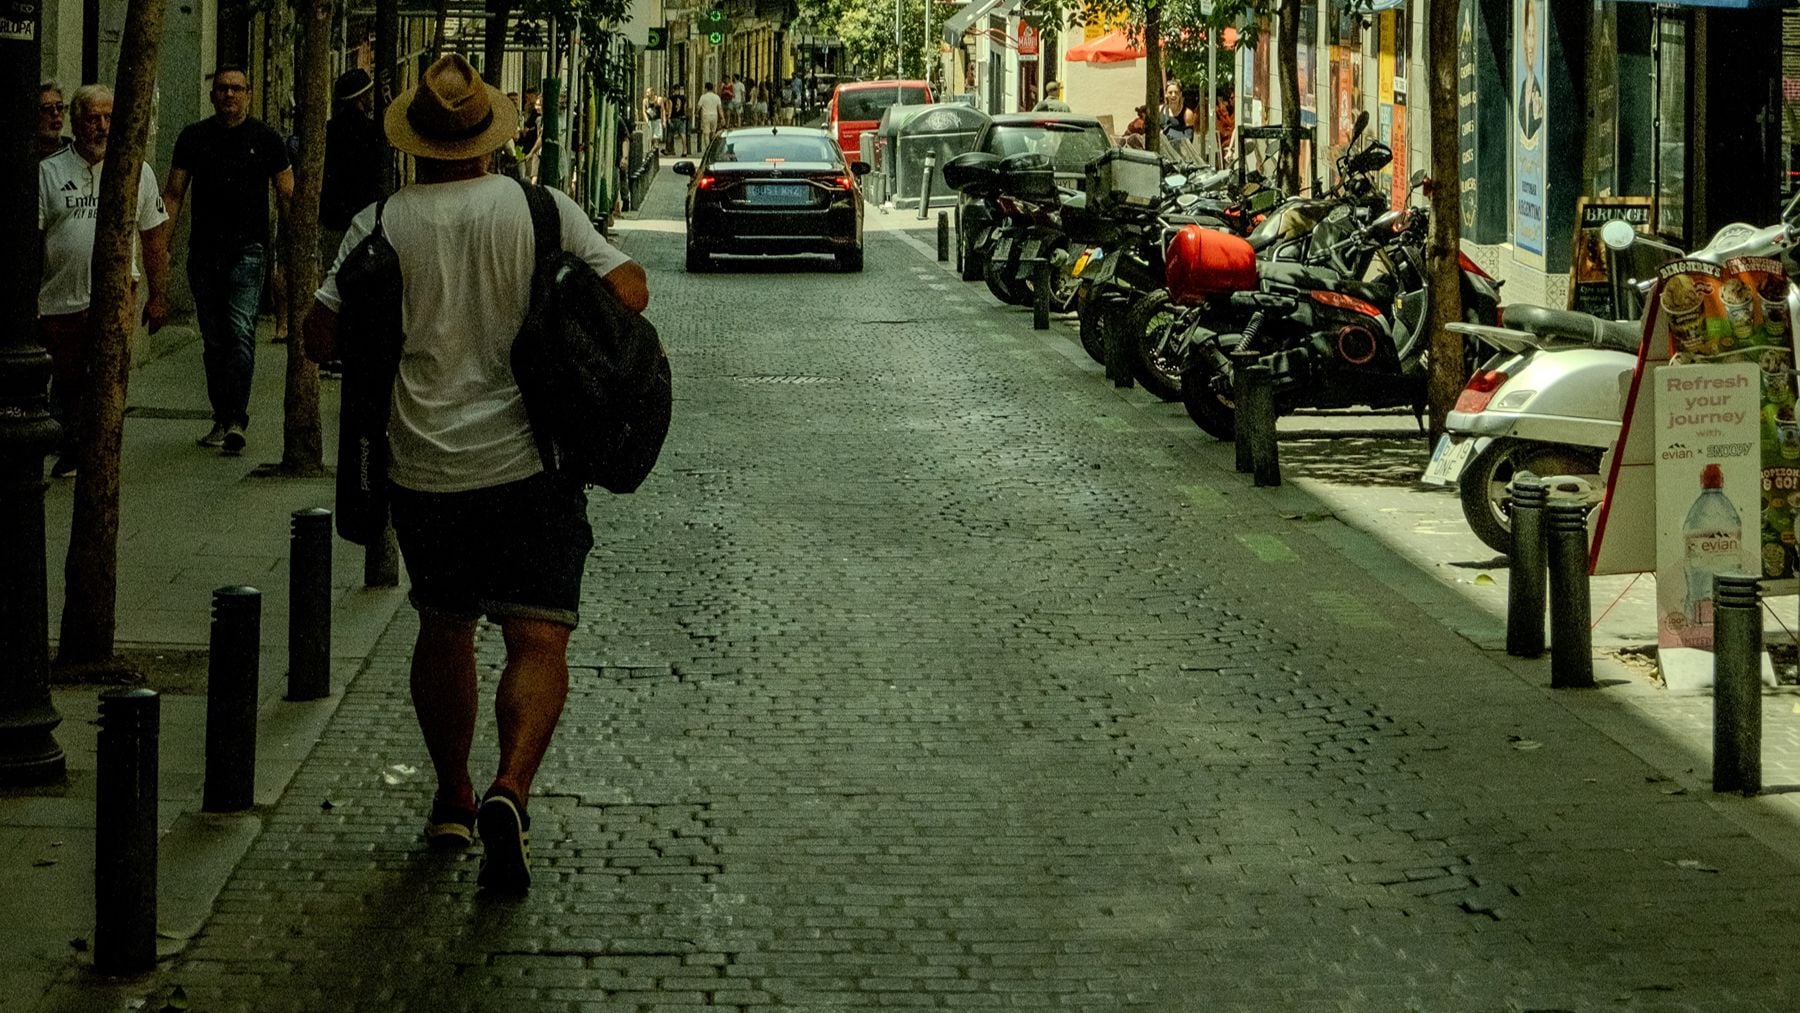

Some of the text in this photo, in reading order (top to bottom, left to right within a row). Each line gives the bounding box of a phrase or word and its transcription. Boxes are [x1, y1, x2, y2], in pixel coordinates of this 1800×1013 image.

[1586, 207, 1649, 222] BRUNCH
[1667, 375, 1749, 392] Refresh
[1685, 396, 1731, 411] your
[1668, 411, 1745, 429] journey
[1696, 430, 1722, 438] with
[1662, 449, 1693, 460] evian
[1707, 443, 1753, 458] SNOOPY
[1775, 477, 1798, 489] GO!
[1702, 539, 1738, 552] evian
